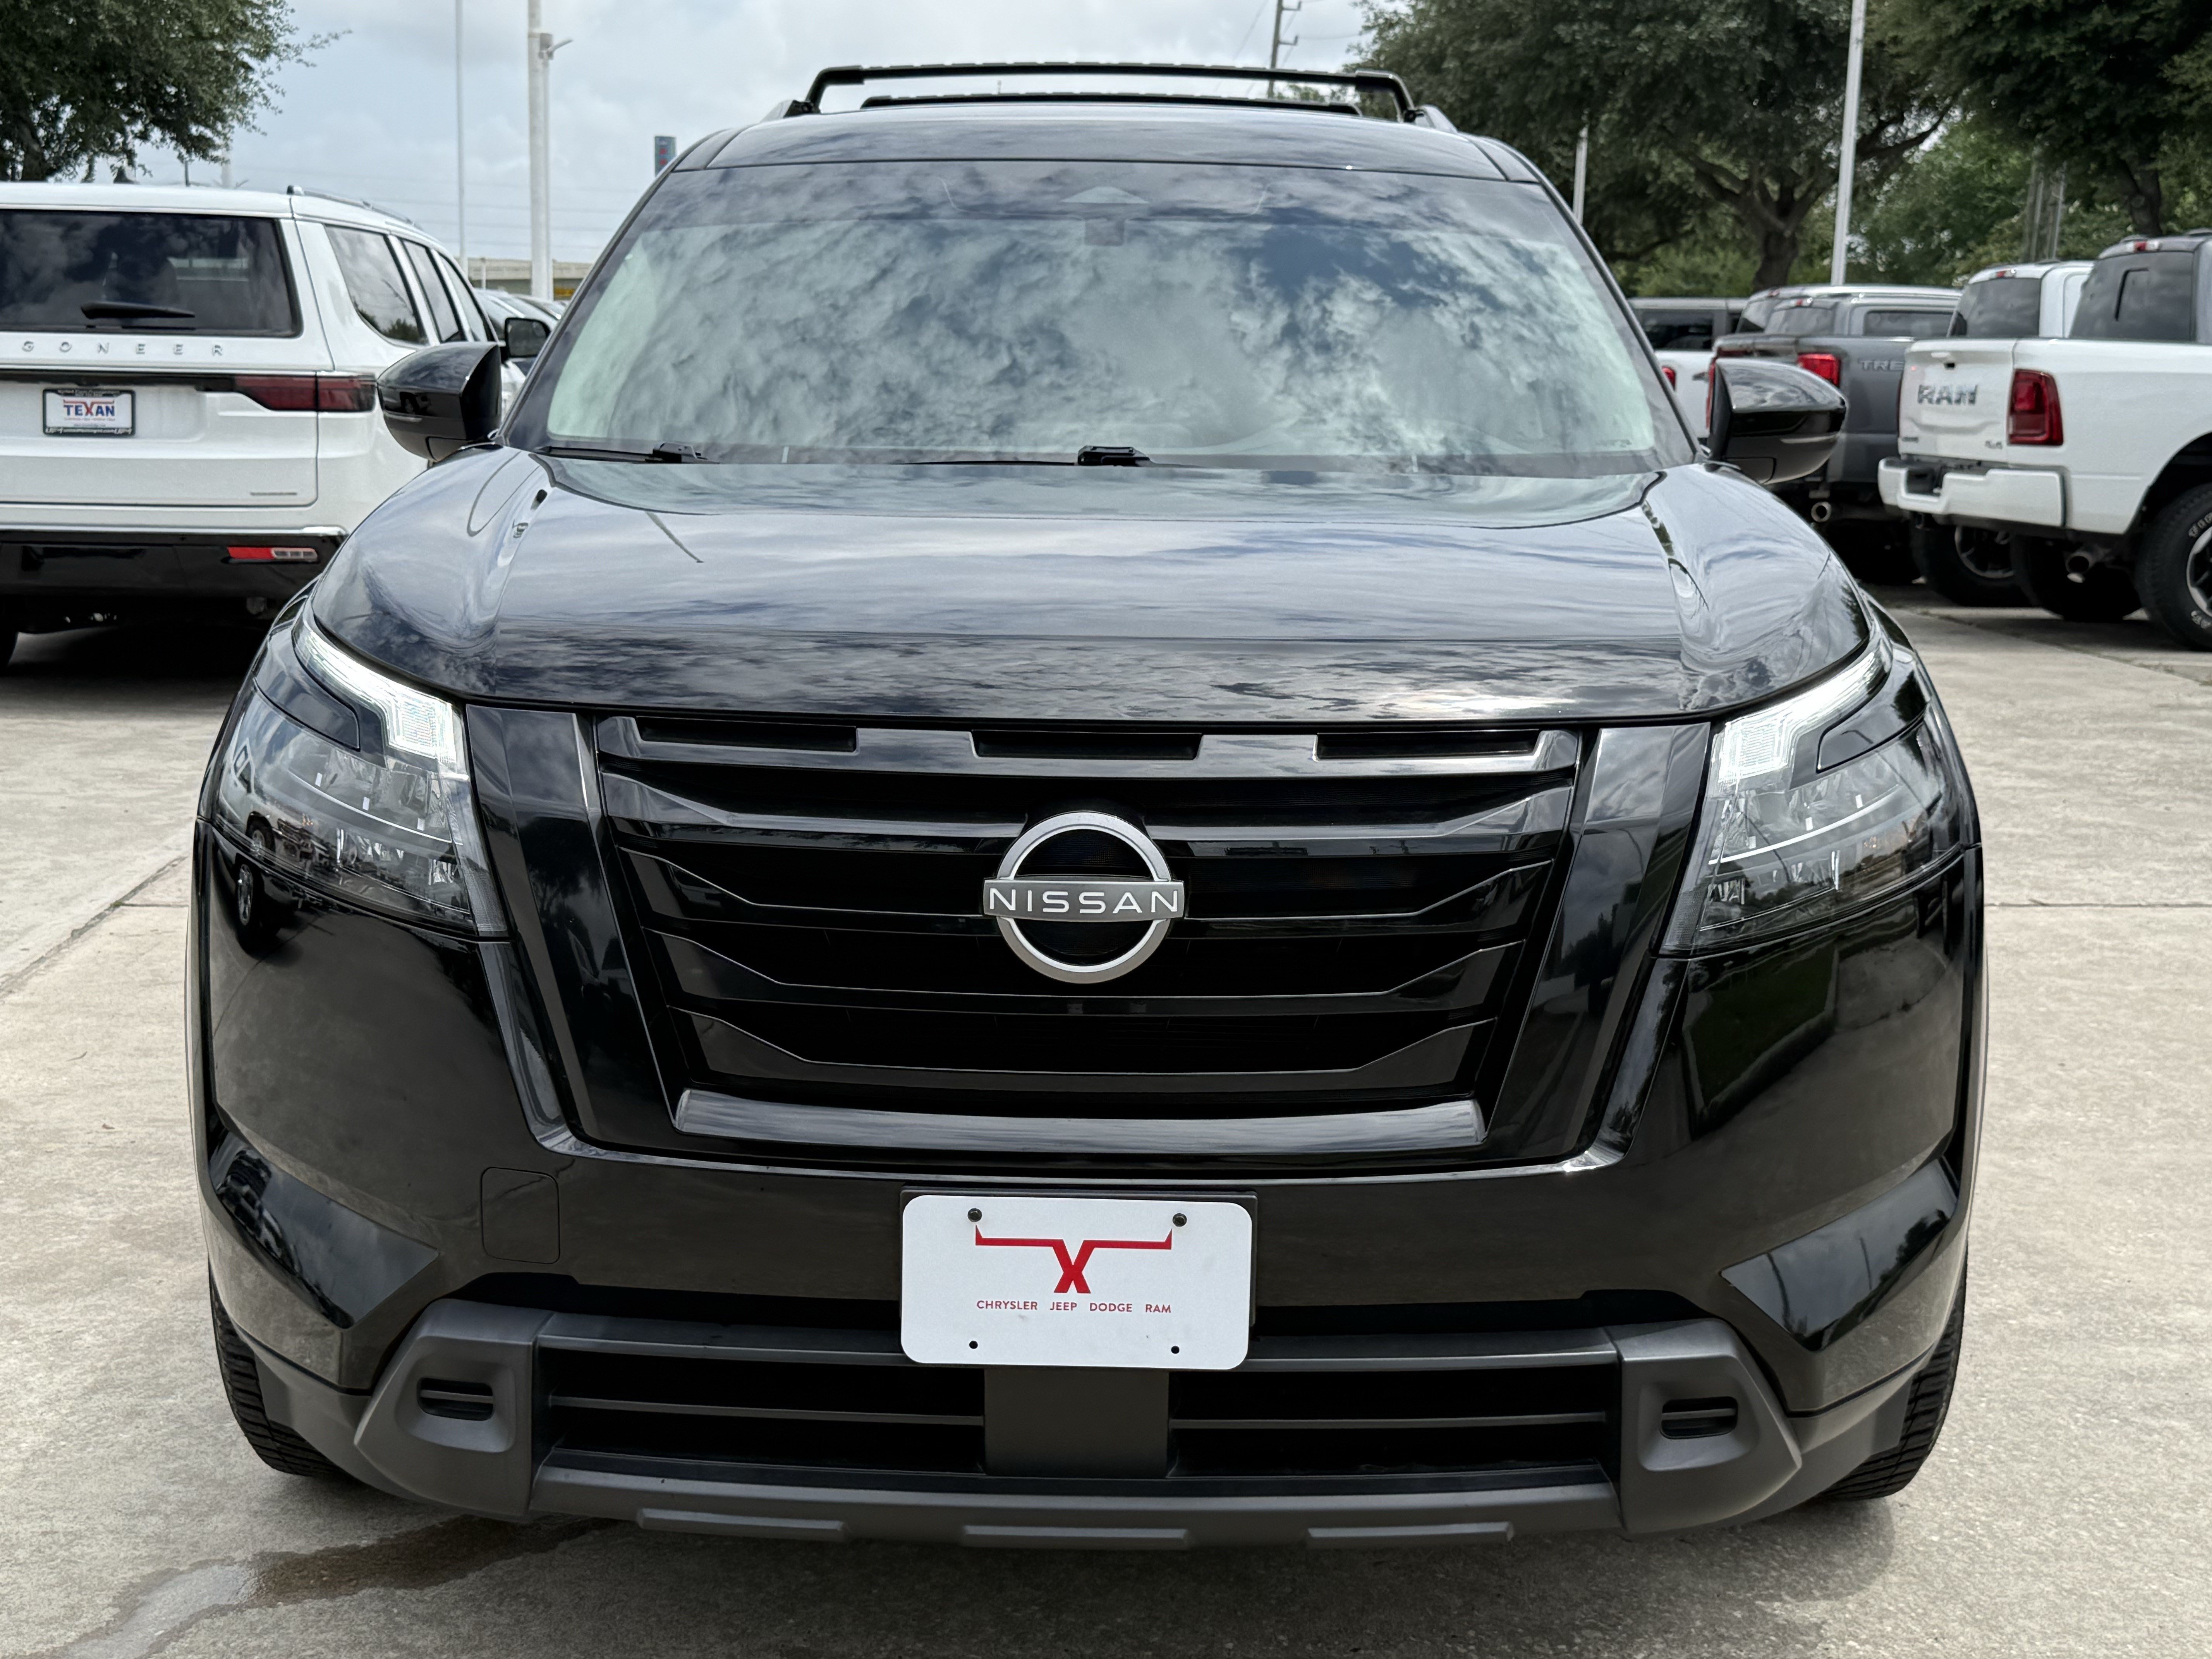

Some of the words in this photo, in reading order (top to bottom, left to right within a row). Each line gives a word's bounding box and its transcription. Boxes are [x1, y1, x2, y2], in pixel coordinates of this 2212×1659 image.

[1918, 385, 1978, 405] RAM
[63, 402, 115, 417] TEXAN
[990, 888, 1177, 914] NISSAN
[976, 1300, 1038, 1310] CHRYSLER
[1050, 1302, 1077, 1311] JEEP
[1089, 1302, 1133, 1312] DODGE
[1145, 1304, 1171, 1313] RAM
